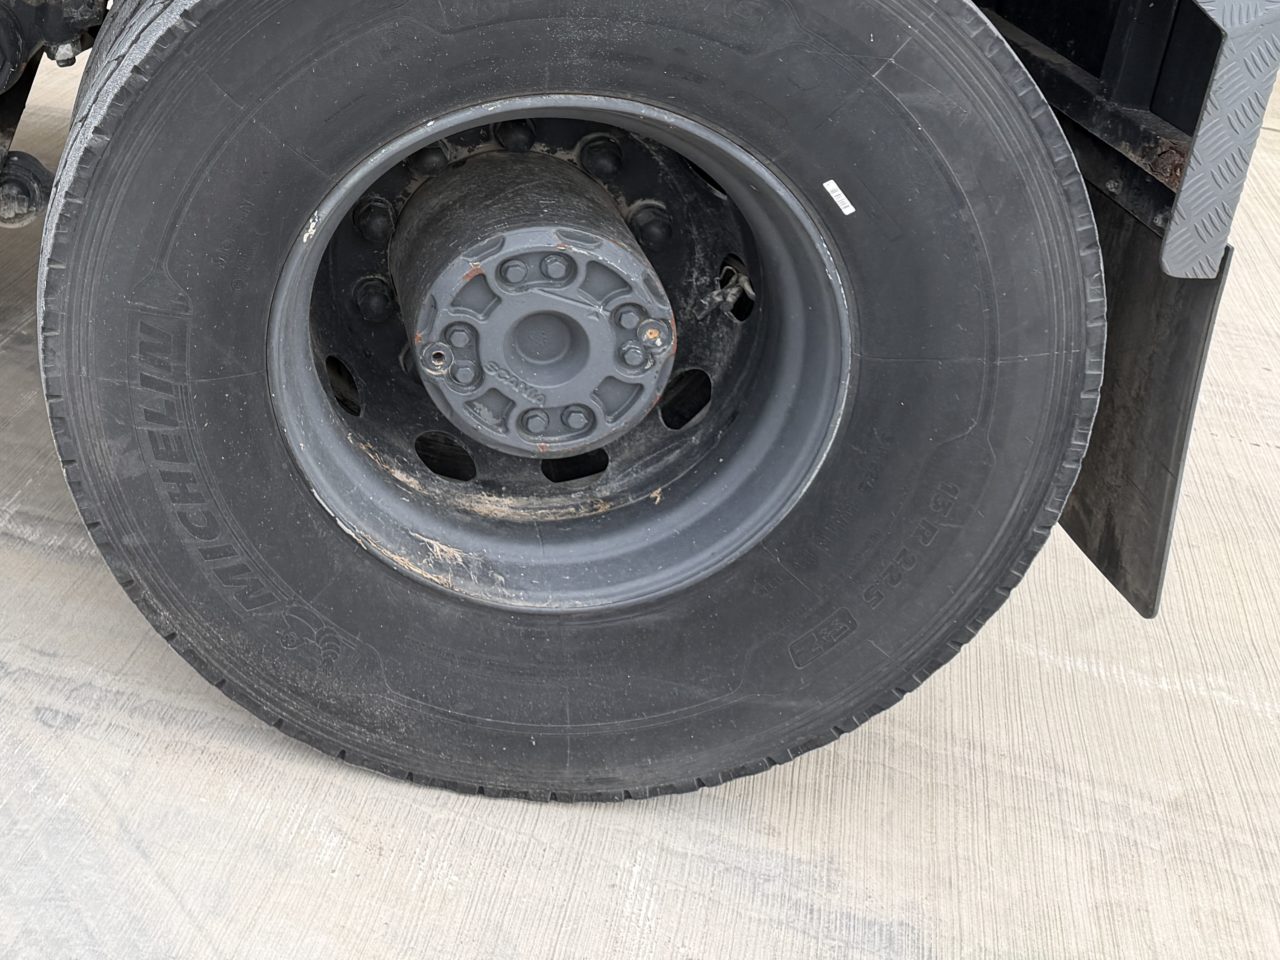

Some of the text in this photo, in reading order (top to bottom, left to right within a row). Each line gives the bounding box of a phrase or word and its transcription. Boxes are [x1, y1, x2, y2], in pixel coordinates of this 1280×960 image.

[484, 359, 547, 407] SCANIA
[136, 318, 282, 614] MICHELIN
[918, 516, 940, 548] R
